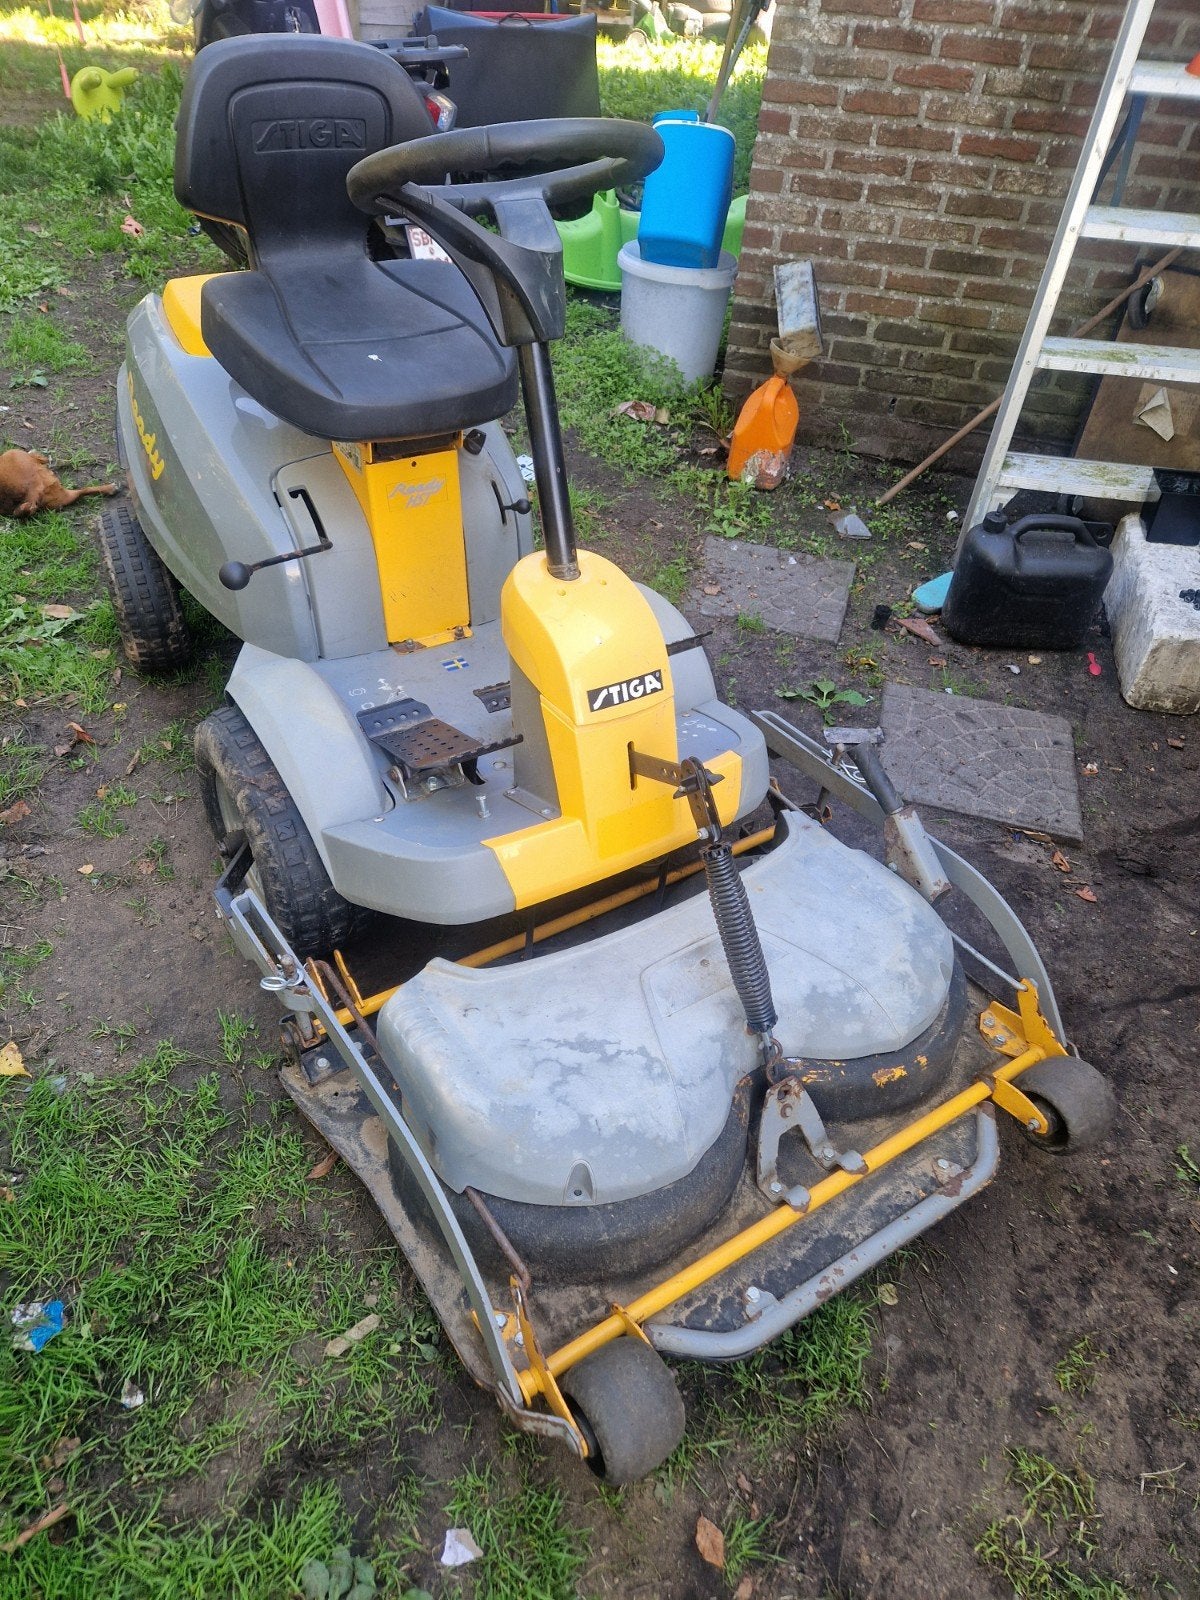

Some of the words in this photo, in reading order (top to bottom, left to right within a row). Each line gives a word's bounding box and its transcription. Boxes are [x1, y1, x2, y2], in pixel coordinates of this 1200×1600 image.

[256, 120, 361, 152] STIGA
[127, 371, 165, 480] Ready
[388, 476, 446, 500] Ready
[592, 673, 661, 711] STIGA
